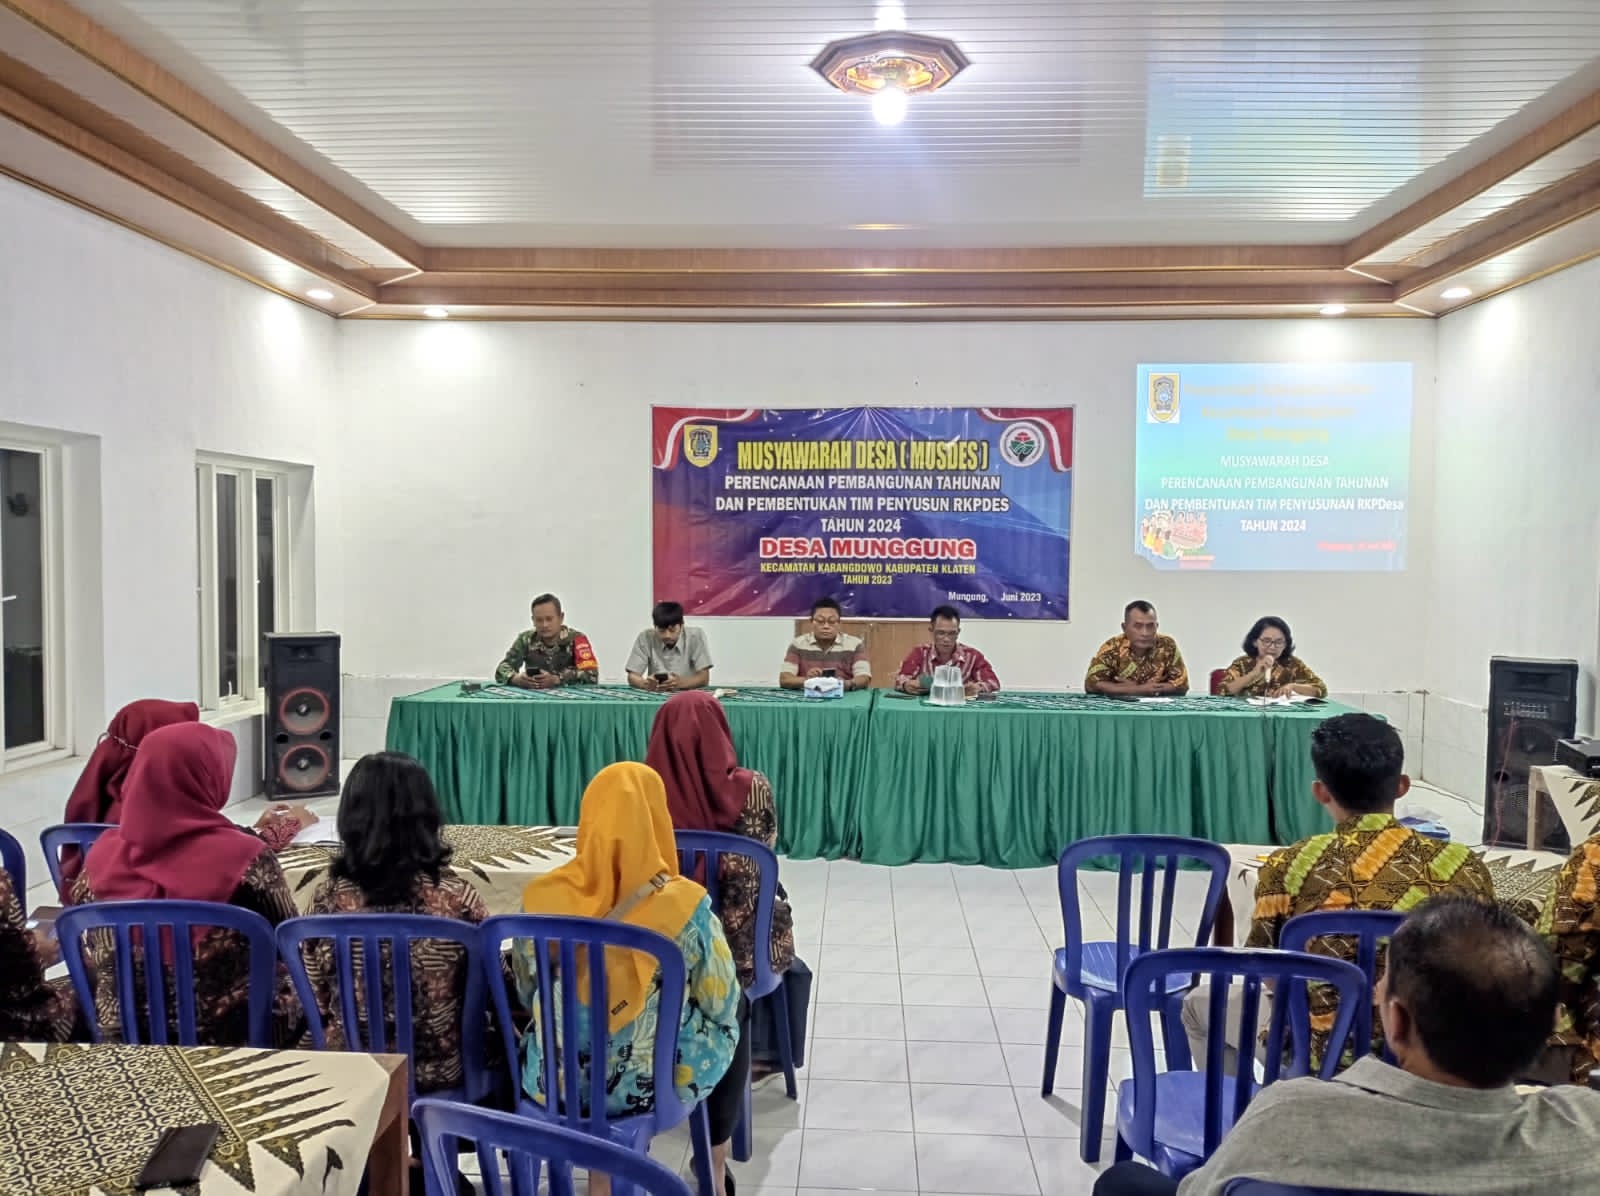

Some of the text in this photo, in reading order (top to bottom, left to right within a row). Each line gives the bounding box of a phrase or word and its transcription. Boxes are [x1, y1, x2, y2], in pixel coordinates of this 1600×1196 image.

[738, 441, 850, 470] MUSYAWARAH
[856, 441, 897, 470] DESA
[1220, 455, 1329, 468] MUSYAWARAH DESA
[724, 475, 1001, 490] PERENCANAAN PEMBANGUNAN TAHUNAN
[1161, 477, 1389, 489] PERENCANAAN PEMBANGUNAN TAHUNAN
[715, 496, 1009, 512] DAN PEMBENTUKAN TIM PENYUSUN RKPDES
[1144, 498, 1404, 511] DAN PEMBENTUKAN TIM PENYUSUNAN RKPDesa
[820, 518, 902, 533] TAHUN 2024
[1240, 519, 1307, 532] TAHUN 2024
[760, 538, 977, 560] DESA MUNGGUNG
[760, 562, 976, 574] KECAMATAN KARANGDOWO KABUPATEN KLATEN
[842, 574, 892, 585] TAHUN 2023
[1000, 592, 1018, 602] Juni
[1020, 592, 1042, 602] 2023
